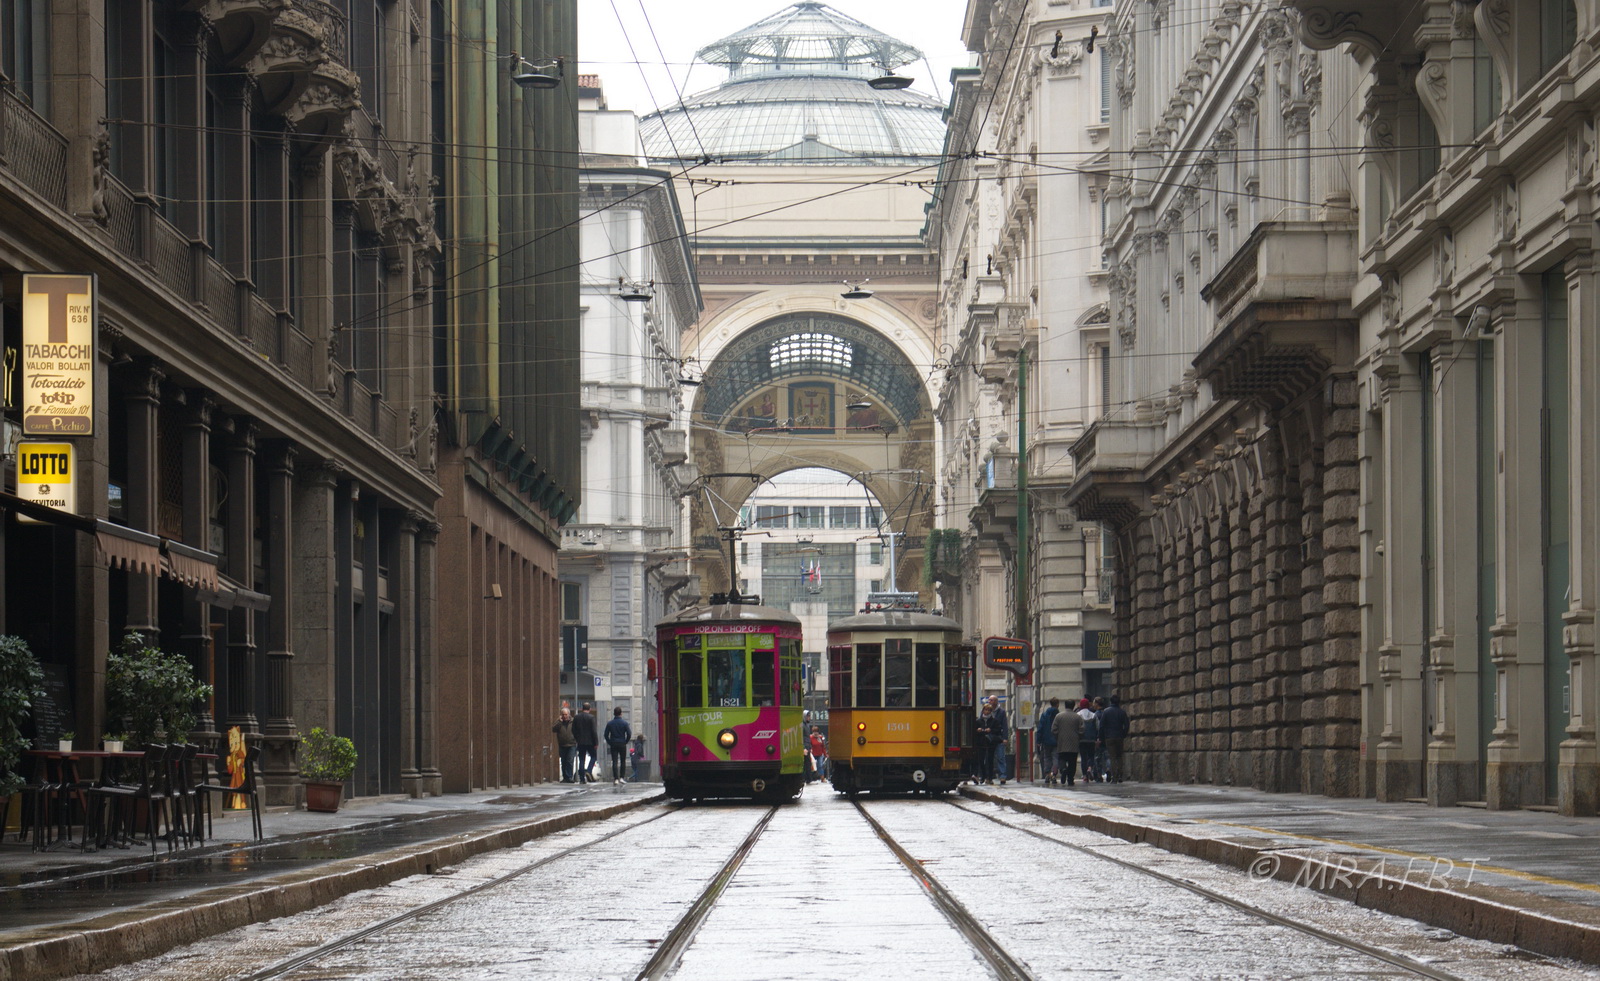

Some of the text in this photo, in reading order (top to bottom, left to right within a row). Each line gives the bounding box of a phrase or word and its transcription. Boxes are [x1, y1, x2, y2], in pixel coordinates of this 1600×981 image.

[28, 276, 88, 344] T
[69, 305, 82, 313] RIV.
[71, 315, 88, 323] 636
[25, 344, 90, 359] TABACCHI
[26, 362, 90, 371] VALORI BOLLATI
[27, 373, 86, 389] Totocalcio
[40, 392, 75, 405] totip
[78, 405, 90, 414] 101
[51, 417, 85, 431] Picchio
[22, 453, 68, 475] LOTTO
[694, 625, 710, 633] HOP
[711, 625, 723, 633] ON
[730, 625, 746, 633] HOP
[748, 625, 761, 633] OFF
[720, 698, 740, 707] 1821
[679, 711, 723, 725] CITY TOUR
[782, 726, 798, 754] CITY
